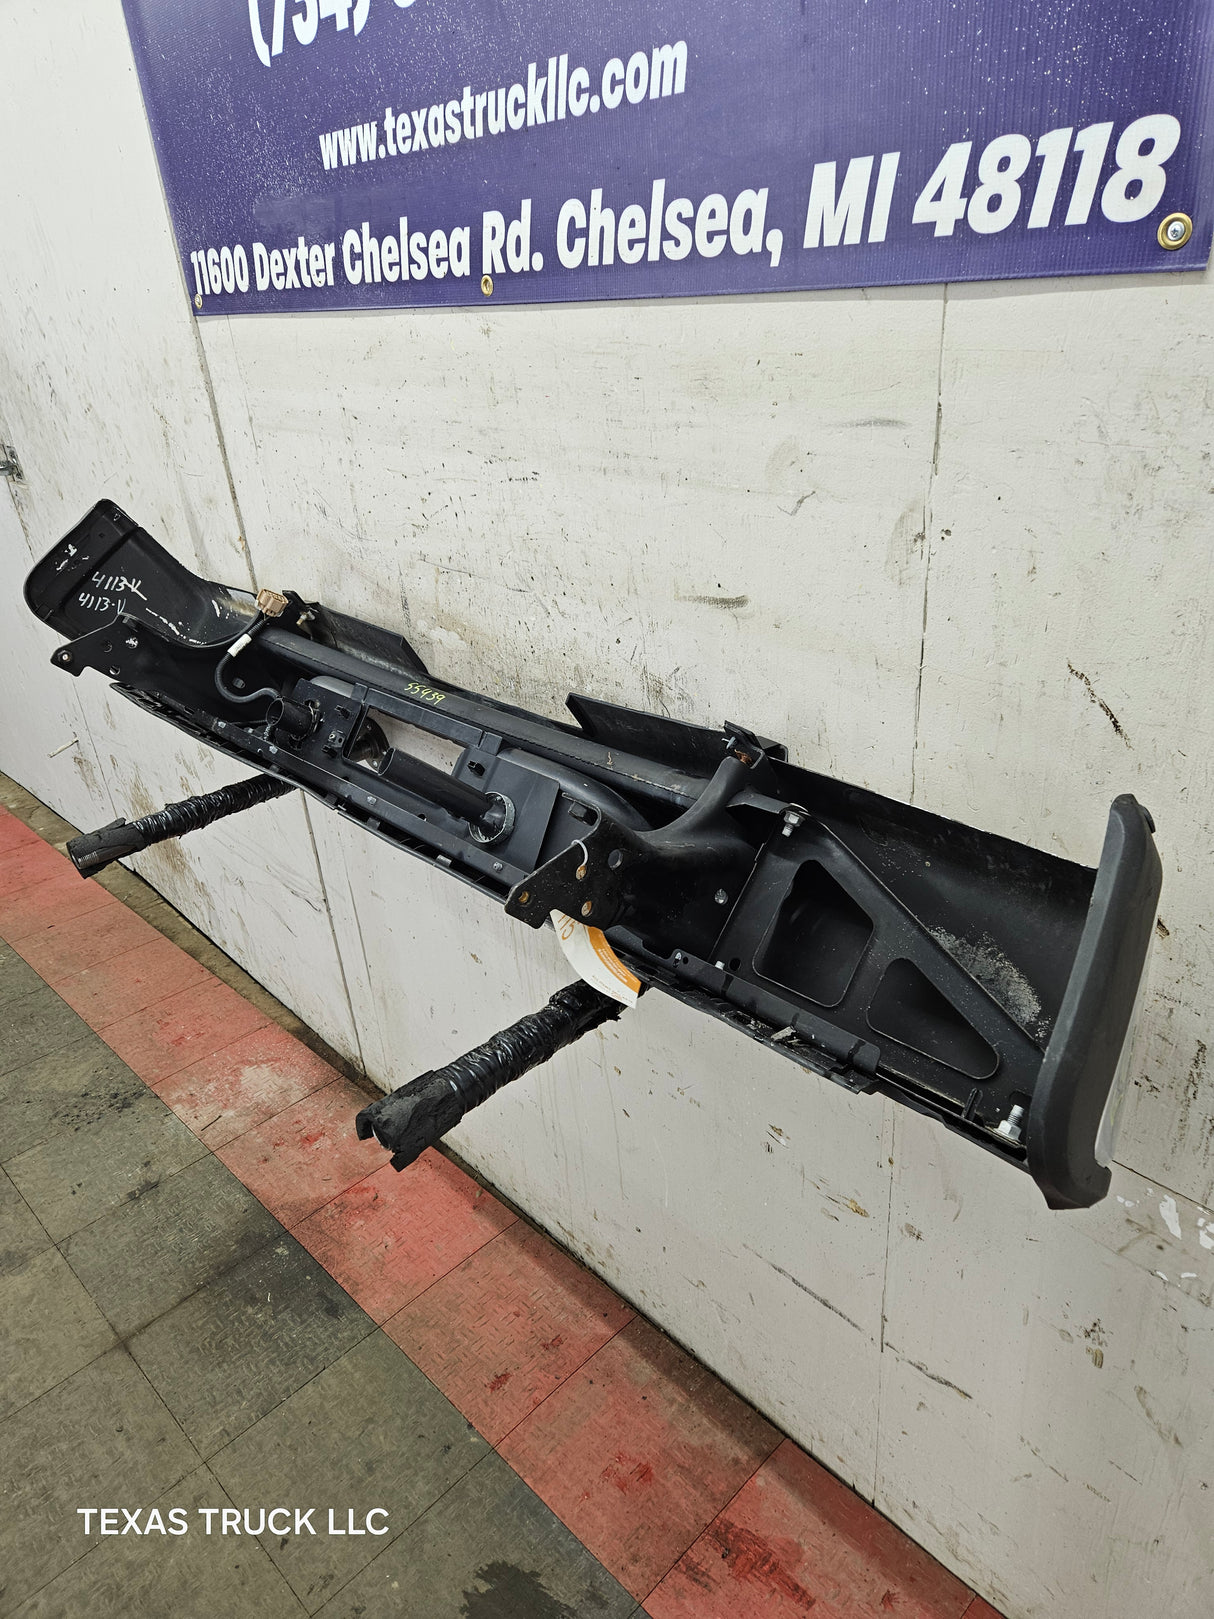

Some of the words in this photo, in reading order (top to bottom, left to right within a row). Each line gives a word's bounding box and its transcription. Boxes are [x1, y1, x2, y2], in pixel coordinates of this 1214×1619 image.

[319, 40, 688, 170] www.texastruckllc.com
[190, 244, 250, 295] 11600
[252, 236, 335, 291] Dexter
[342, 217, 471, 285] Chelsea
[483, 199, 543, 274] Rd.
[557, 178, 784, 269] Chelsea,
[802, 151, 901, 249] MI
[911, 113, 1182, 238] 48118
